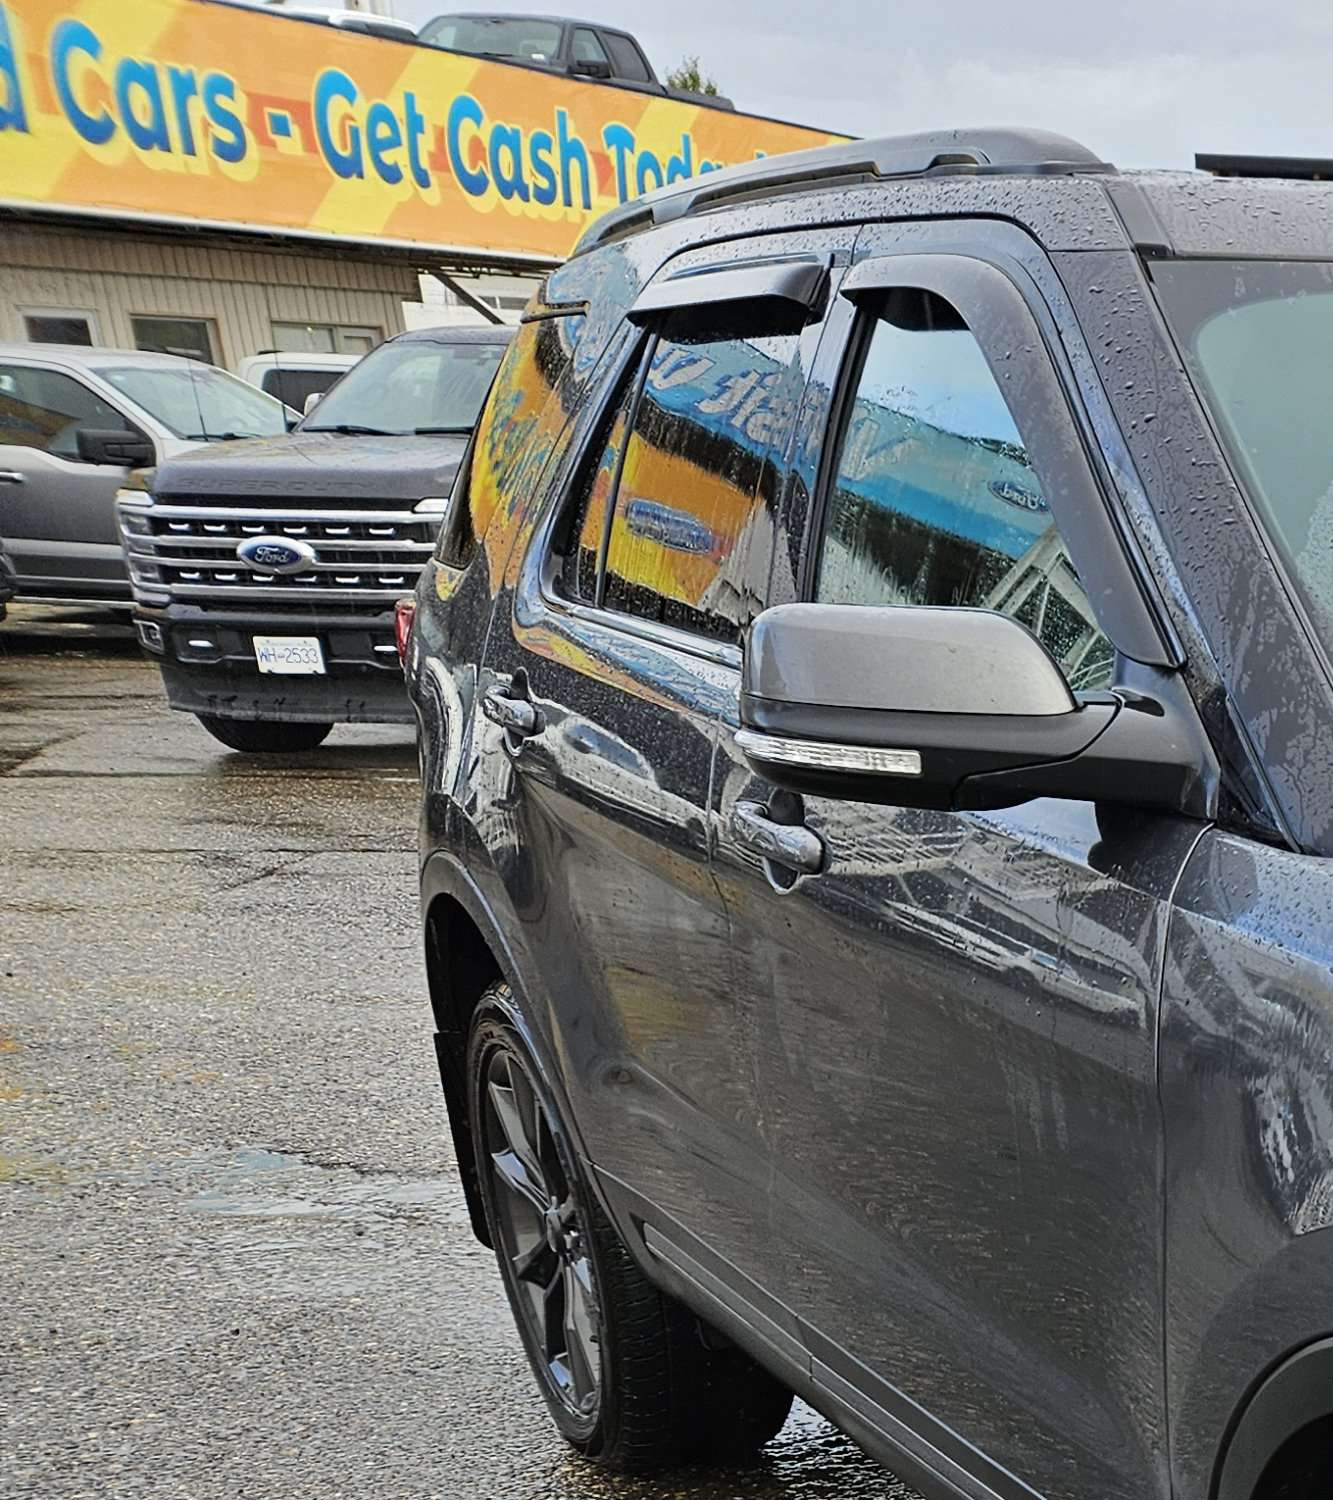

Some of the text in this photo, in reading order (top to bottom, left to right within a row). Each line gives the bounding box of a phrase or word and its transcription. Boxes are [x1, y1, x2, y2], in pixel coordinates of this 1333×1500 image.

[51, 18, 247, 163] Cars
[314, 69, 432, 189] Get
[449, 94, 593, 211] Cash
[254, 546, 290, 564] Ford
